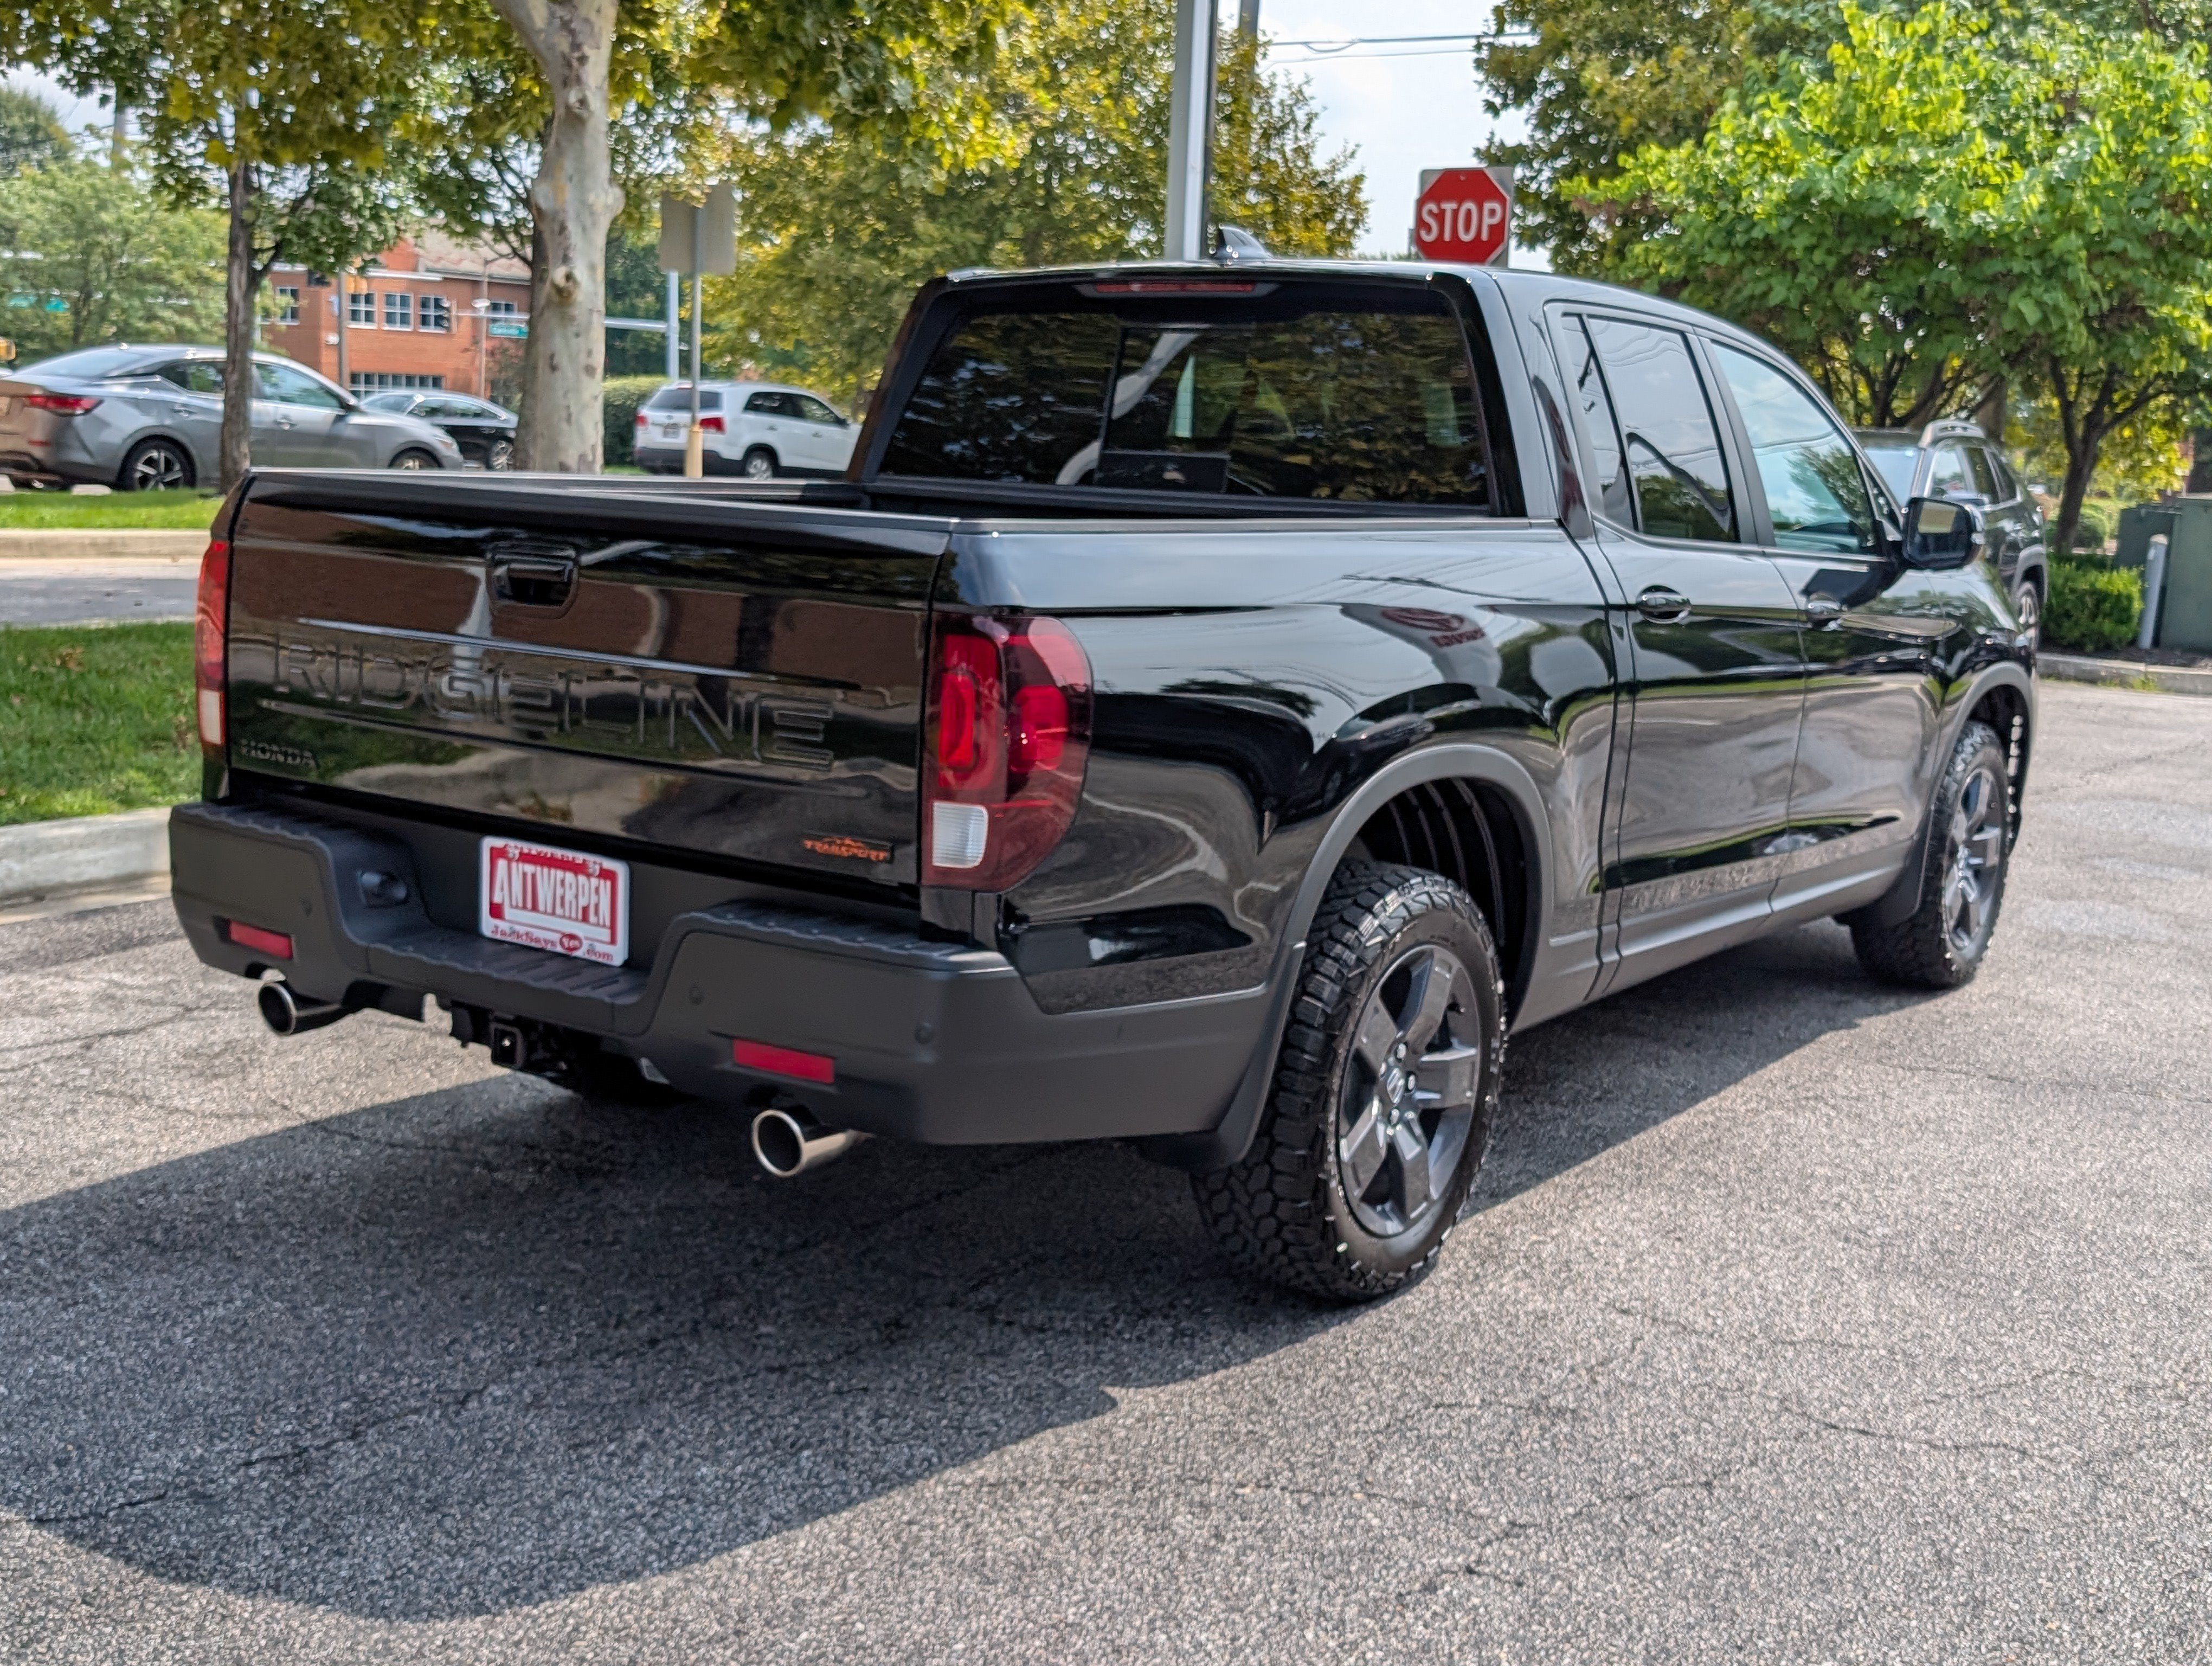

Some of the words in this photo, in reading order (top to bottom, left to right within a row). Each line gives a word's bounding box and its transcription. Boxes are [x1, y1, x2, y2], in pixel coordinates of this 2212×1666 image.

[1419, 202, 1503, 242] STOP
[273, 635, 834, 771] RIDGELINE
[493, 857, 612, 927] ANTWERPEN
